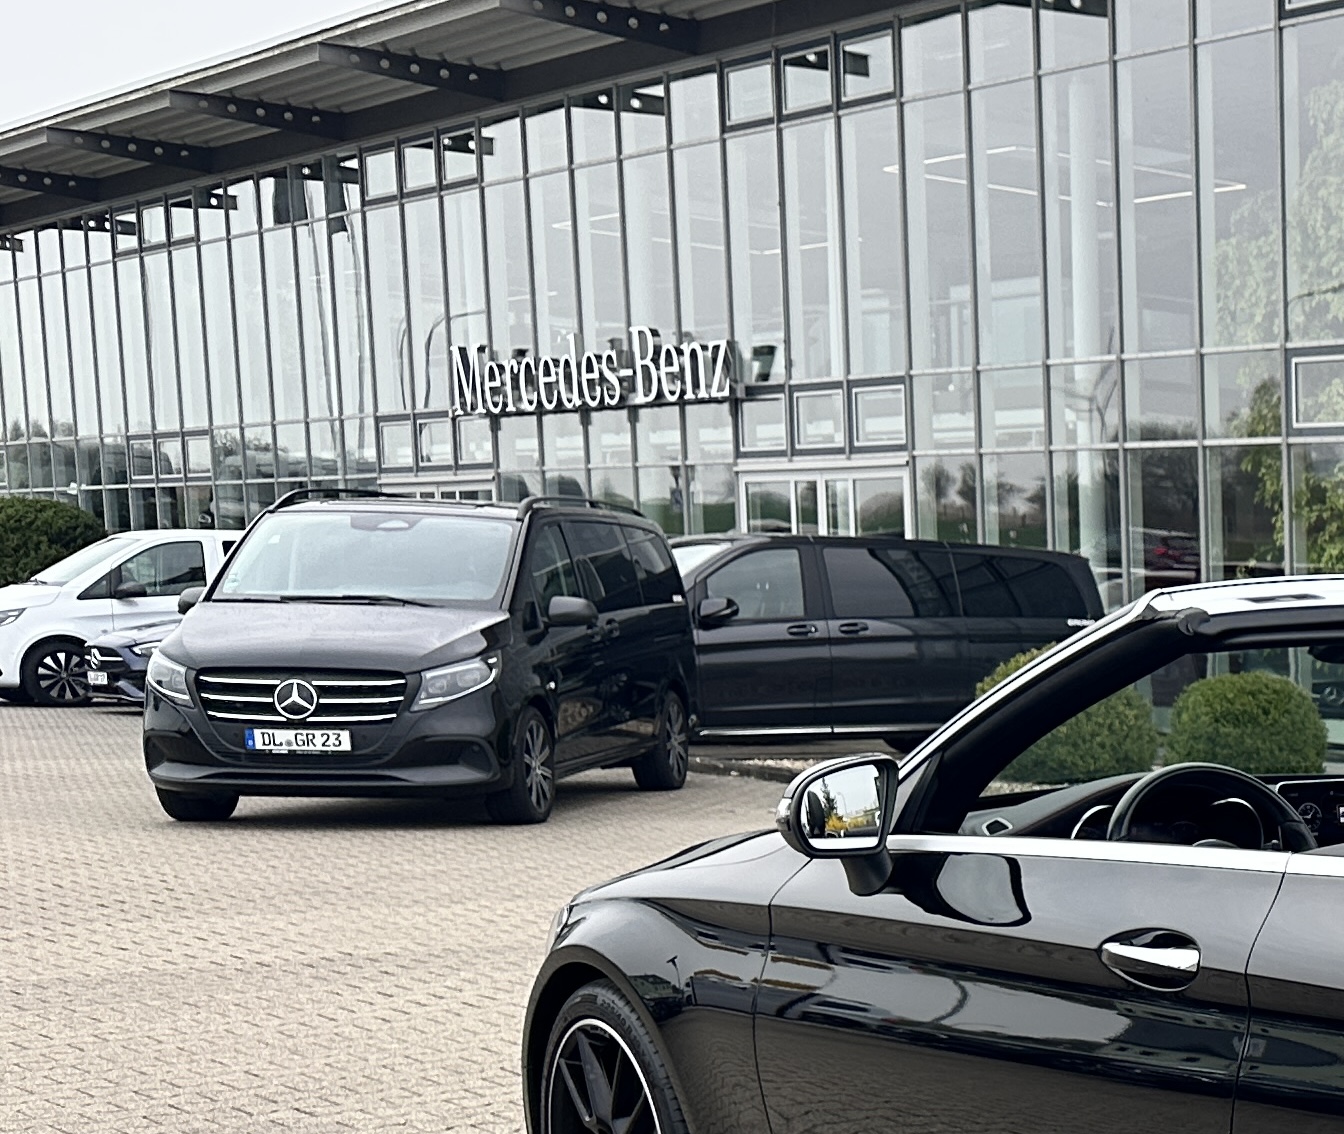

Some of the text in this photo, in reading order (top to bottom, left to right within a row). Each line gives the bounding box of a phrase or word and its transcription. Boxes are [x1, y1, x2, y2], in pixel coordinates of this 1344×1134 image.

[450, 325, 731, 416] Mercedes-Benz
[261, 731, 342, 747] DL GR 23
